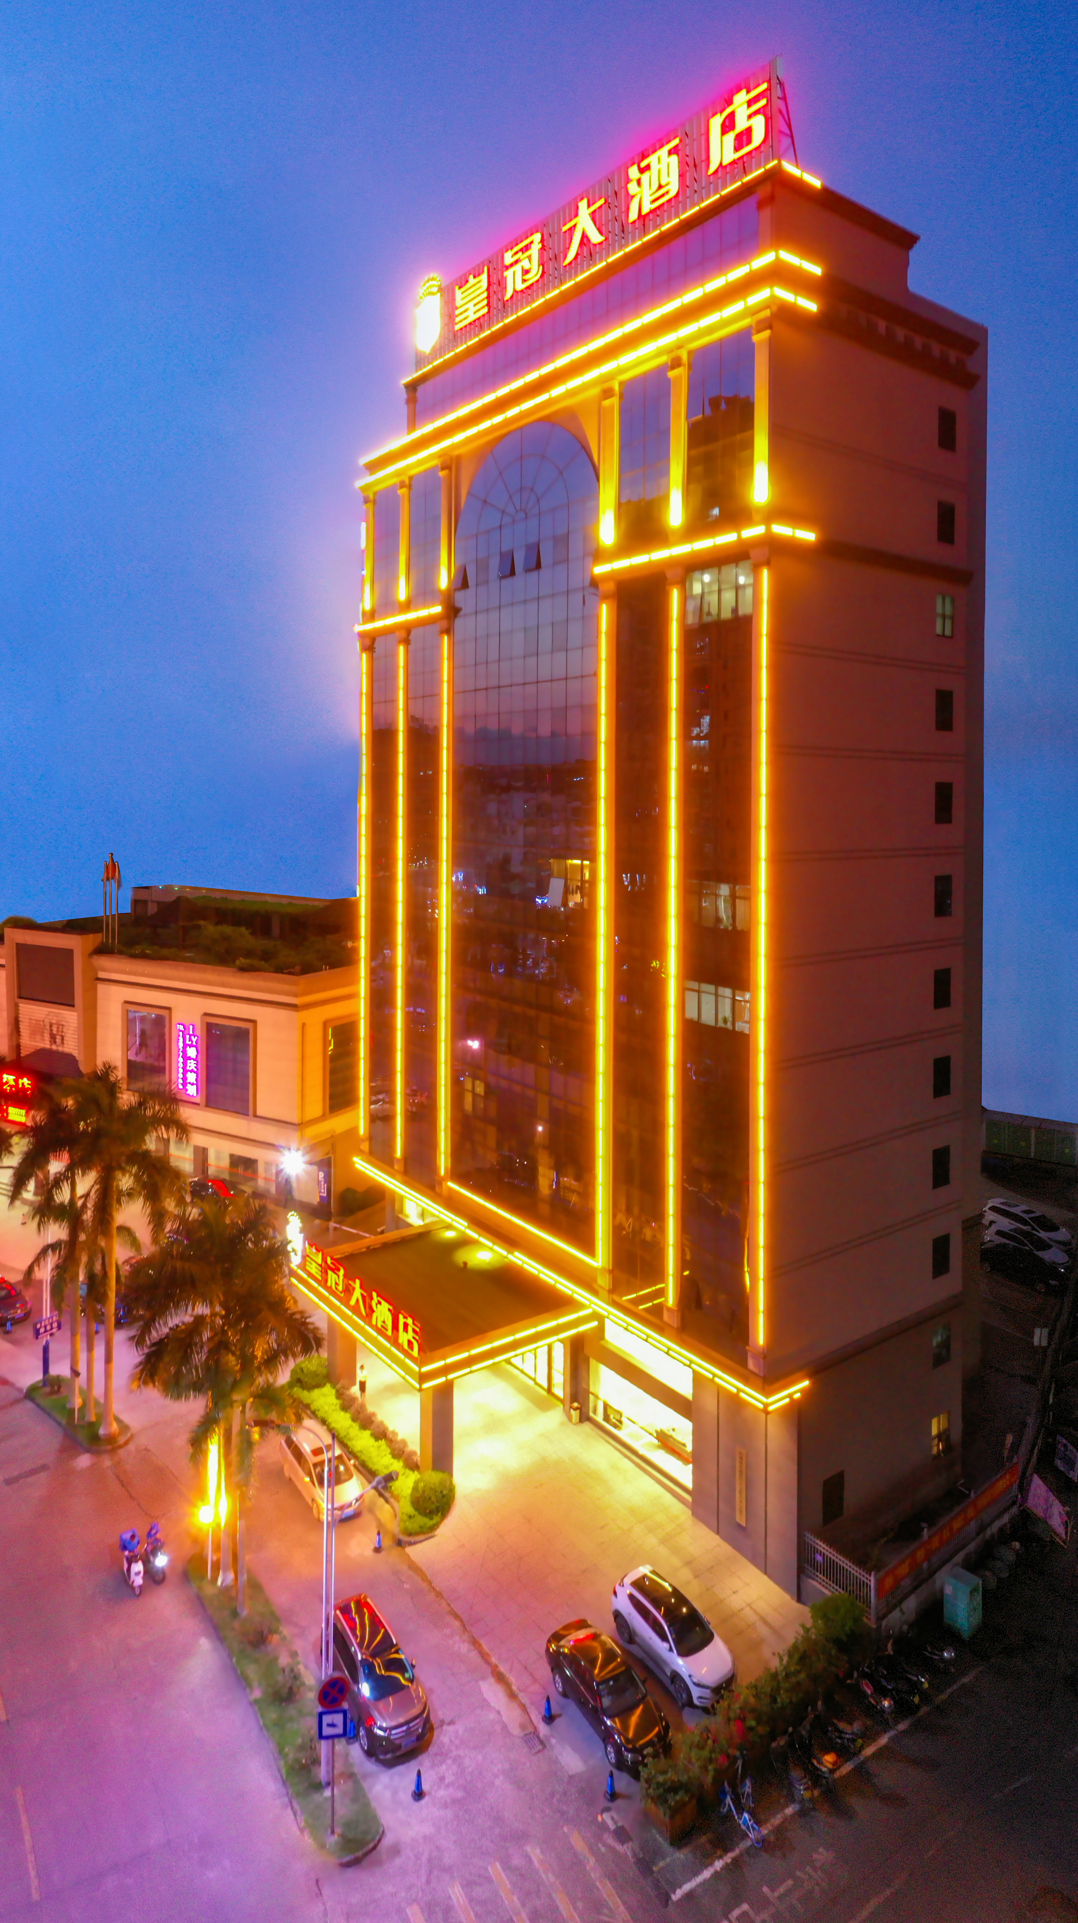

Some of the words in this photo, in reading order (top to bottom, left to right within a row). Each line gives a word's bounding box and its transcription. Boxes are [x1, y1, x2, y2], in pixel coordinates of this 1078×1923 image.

[454, 81, 768, 331] 皇冠大酒店
[305, 1239, 420, 1358] 皇冠大酒店
